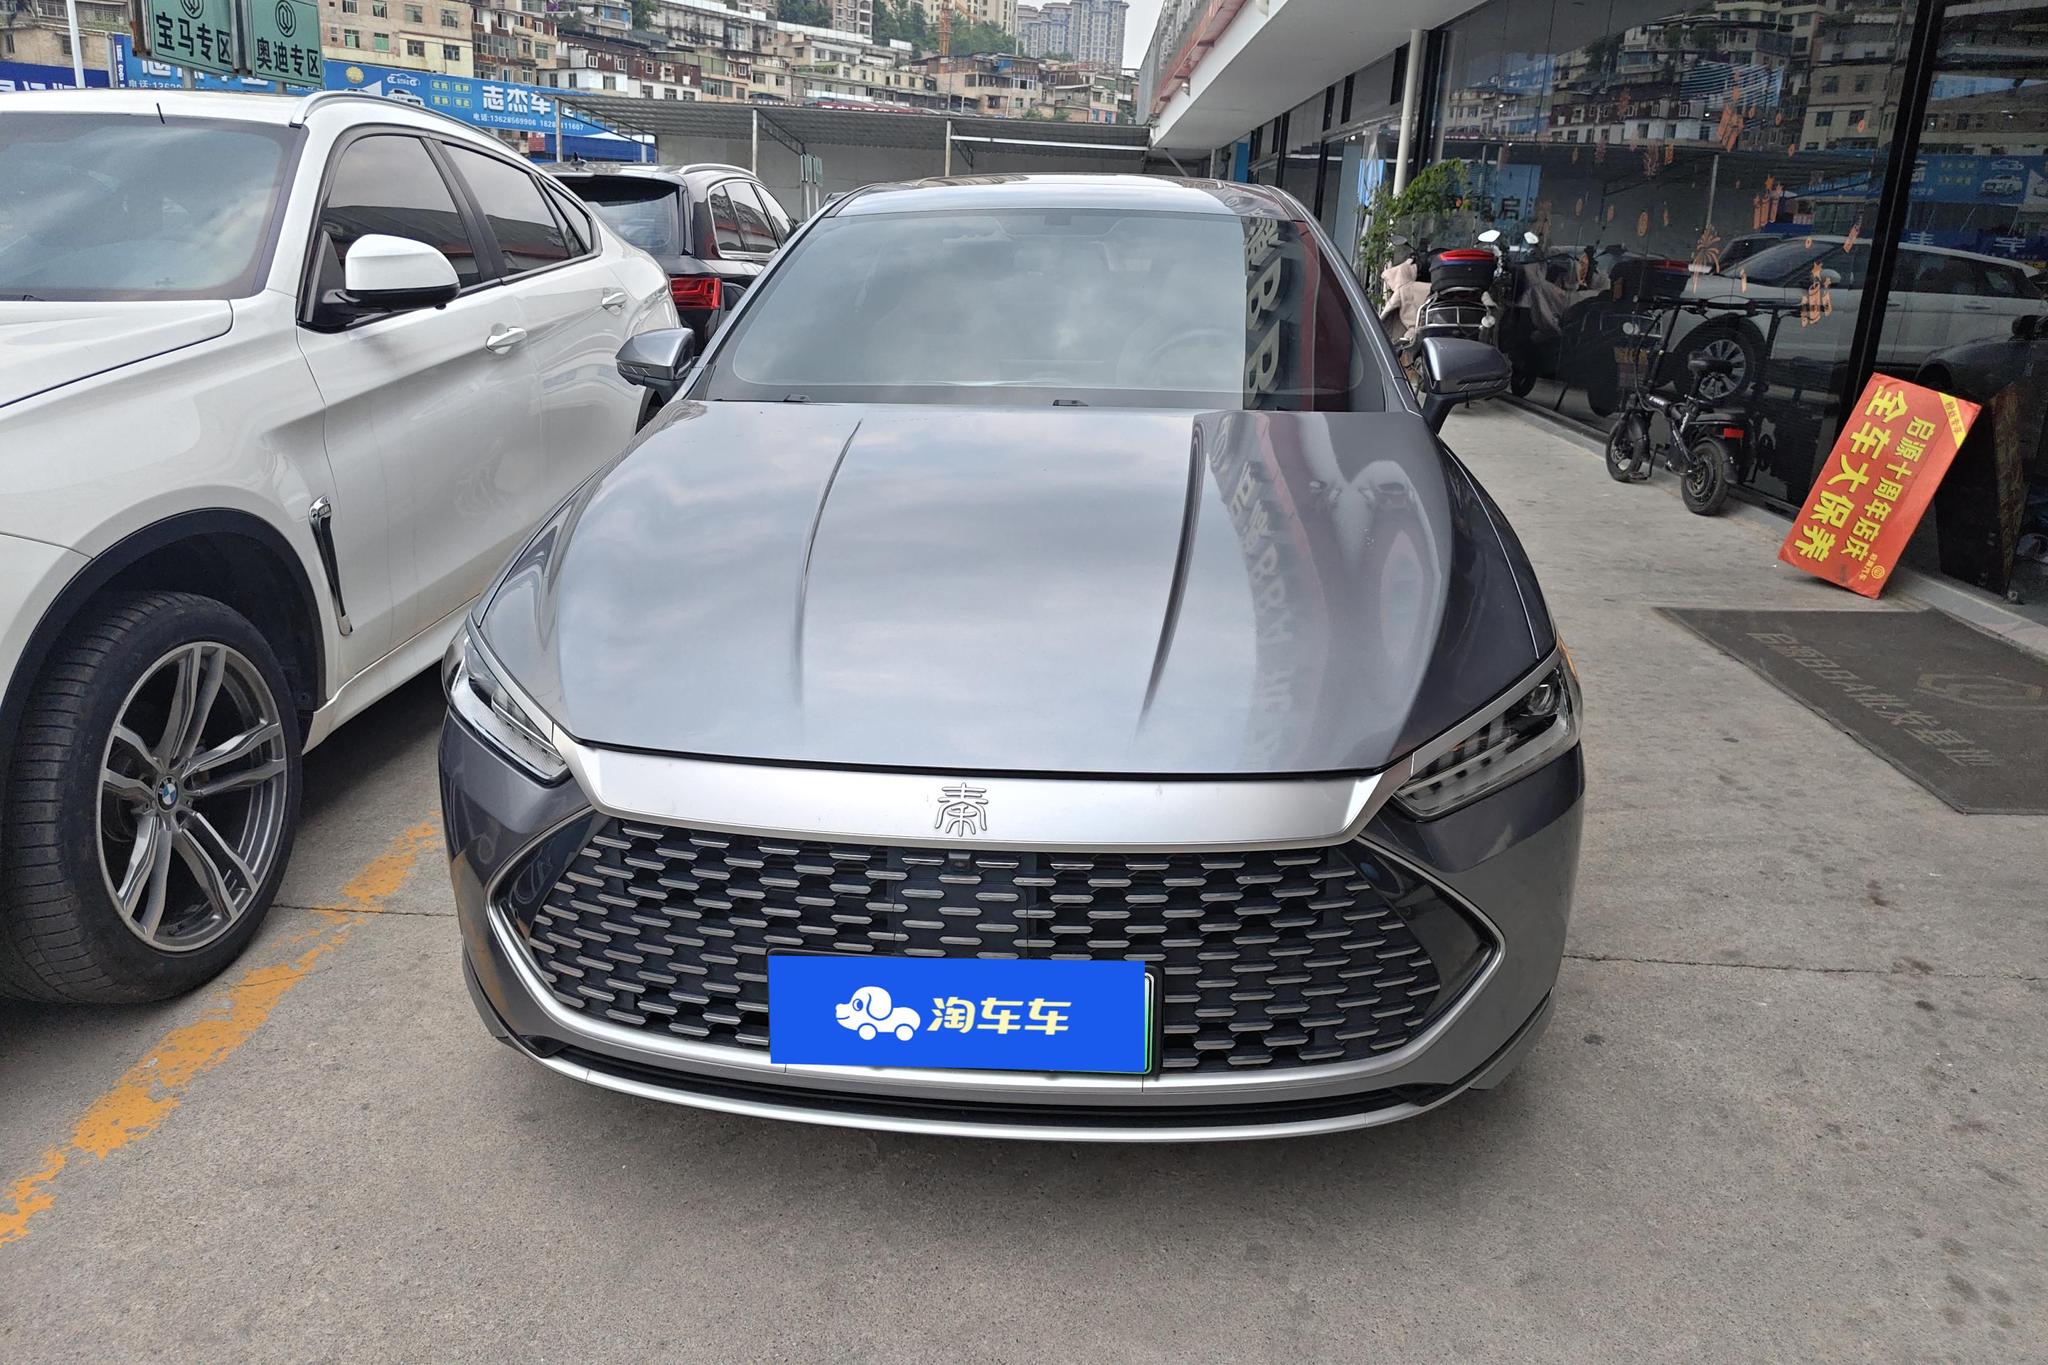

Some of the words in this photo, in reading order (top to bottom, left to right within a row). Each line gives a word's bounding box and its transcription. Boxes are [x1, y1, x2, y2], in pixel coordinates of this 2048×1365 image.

[156, 12, 233, 65] 宝马专区
[256, 37, 321, 79] 奥迪专区
[1794, 385, 1908, 562] 全车大保养
[1841, 415, 1936, 562] 启源十周年店庆
[934, 782, 989, 837] 秦
